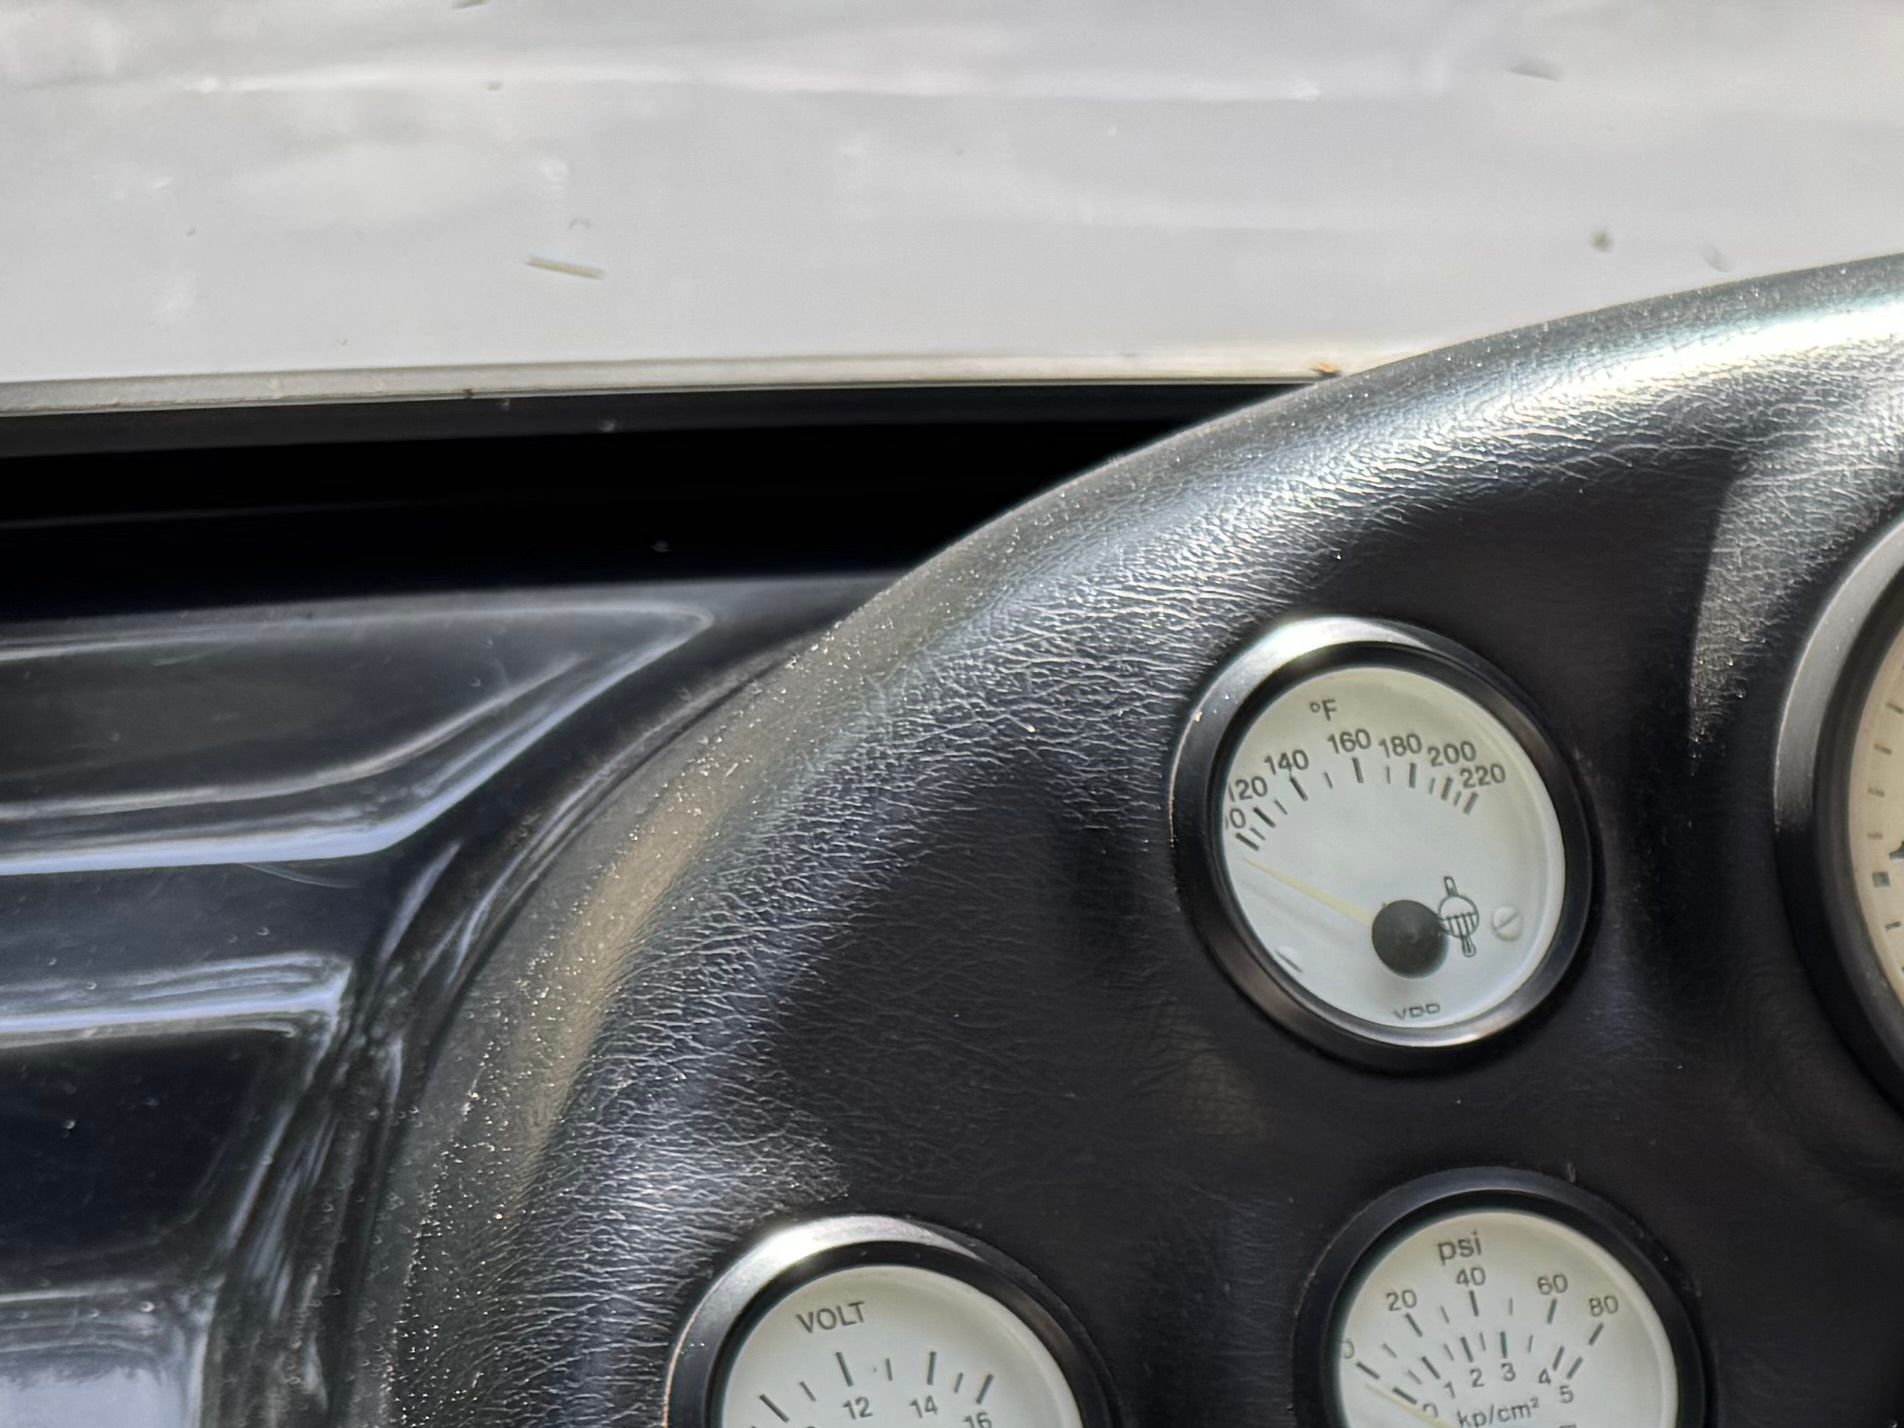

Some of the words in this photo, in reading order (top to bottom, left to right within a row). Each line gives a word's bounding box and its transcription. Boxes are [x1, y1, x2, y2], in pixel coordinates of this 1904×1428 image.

[1264, 749, 1309, 776] 140
[1328, 728, 1371, 755] 160
[1379, 733, 1422, 758] 180
[1427, 741, 1476, 766] 200
[1460, 764, 1505, 788] 220
[1437, 1231, 1482, 1266] psi
[1386, 1290, 1417, 1311] 20
[1456, 1266, 1486, 1287] 40
[1537, 1274, 1568, 1295] 60
[1589, 1295, 1619, 1317] 80
[796, 1302, 867, 1334] VOLT
[1469, 1369, 1485, 1387] 2
[1502, 1363, 1516, 1381] 3
[1539, 1368, 1551, 1385] 4
[1559, 1385, 1574, 1403] 5
[842, 1399, 873, 1419] 12
[910, 1397, 938, 1419] 14
